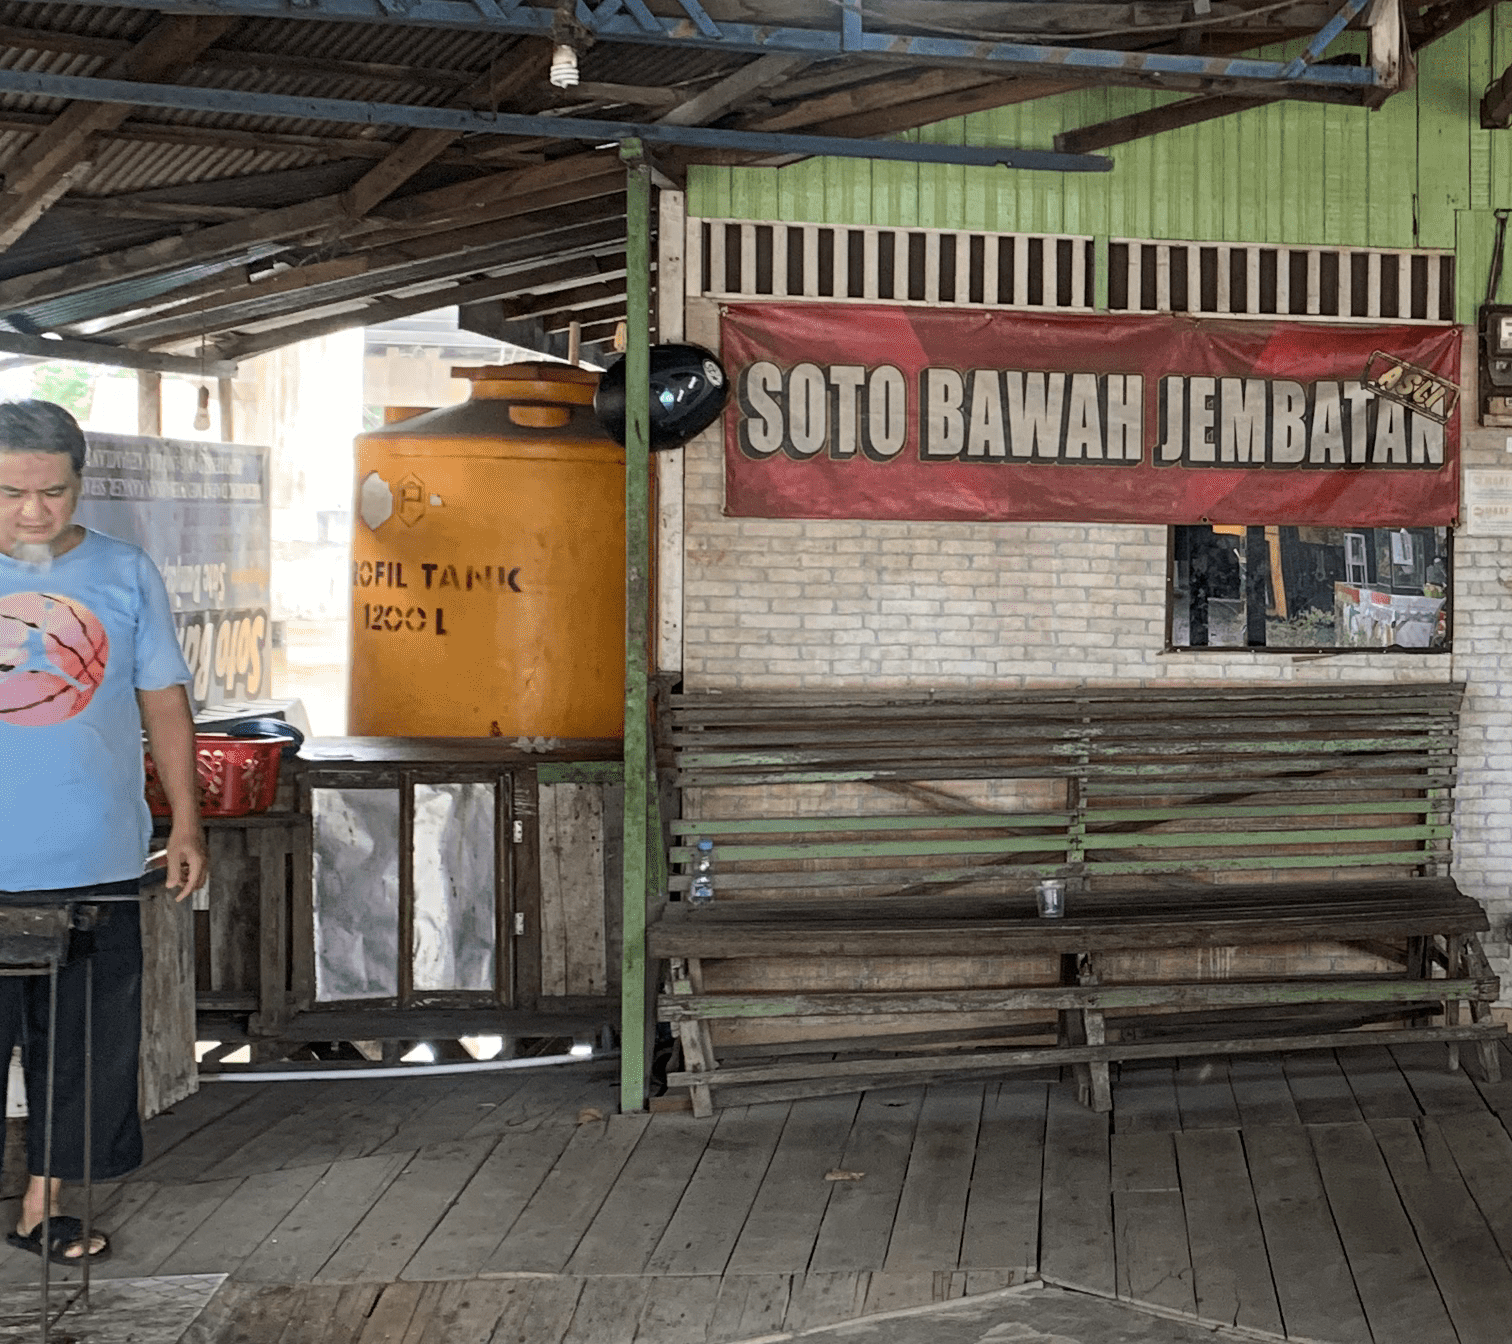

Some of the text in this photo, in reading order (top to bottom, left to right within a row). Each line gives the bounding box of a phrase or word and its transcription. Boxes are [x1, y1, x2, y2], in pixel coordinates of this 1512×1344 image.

[741, 361, 1445, 467] SOTO BAWAH JEMBATAN
[421, 562, 524, 594] TANK
[364, 602, 448, 636] 1200 L
